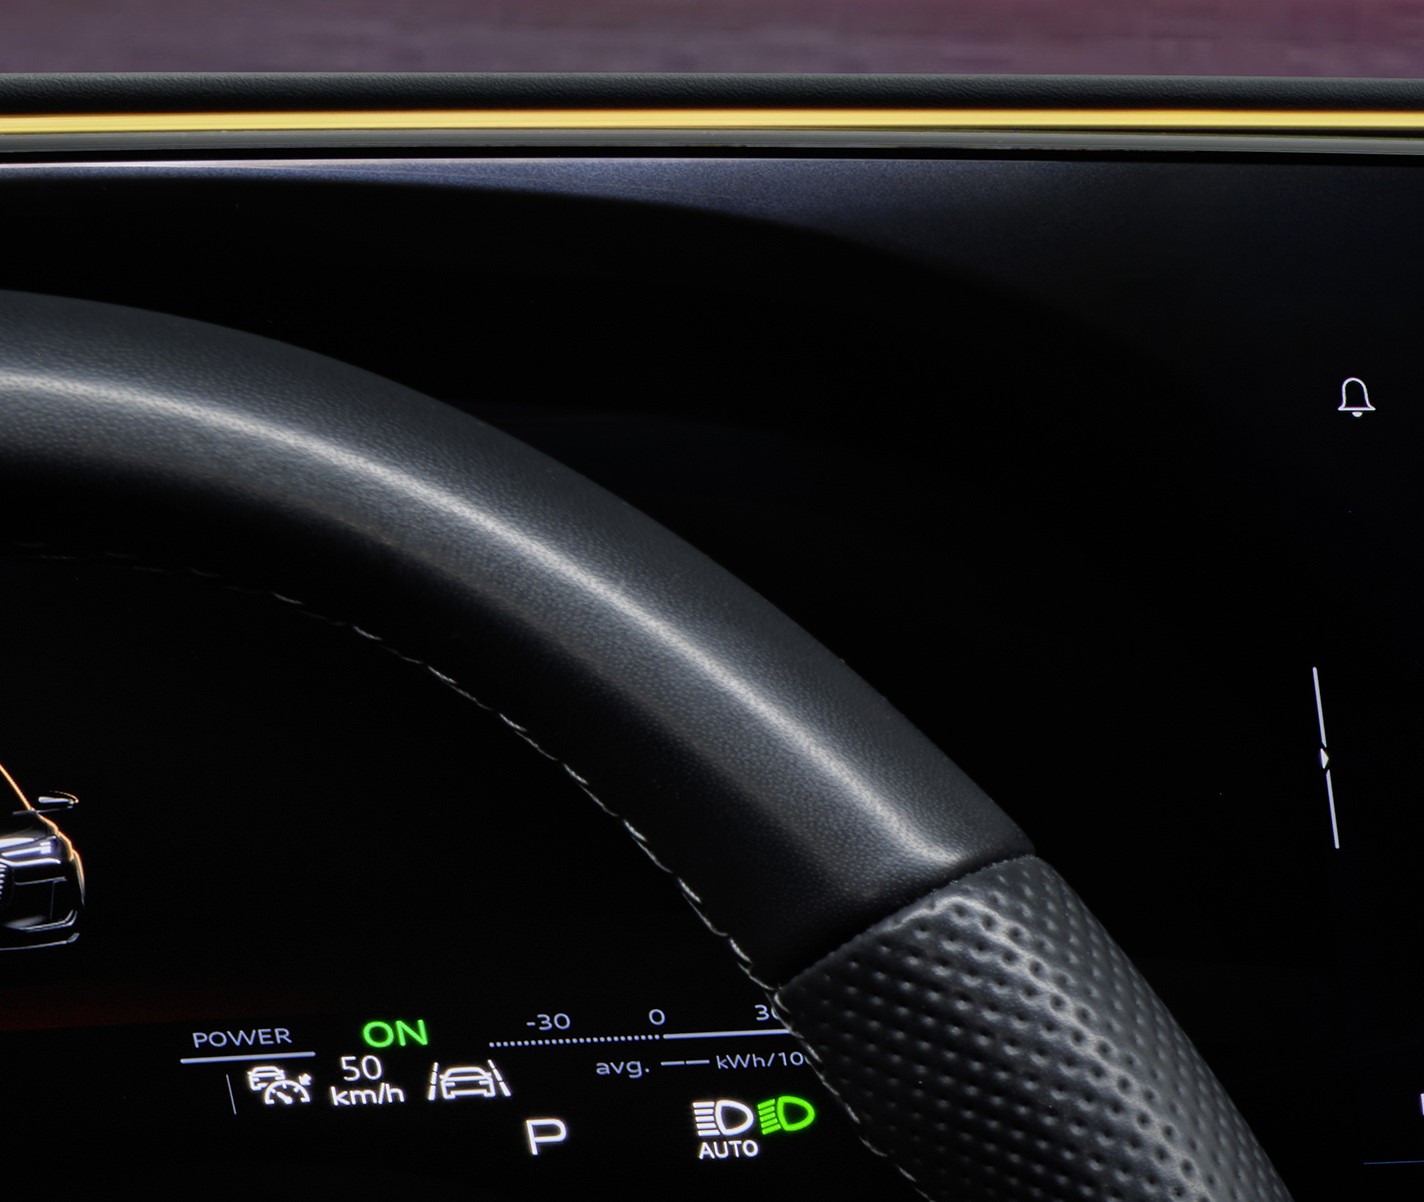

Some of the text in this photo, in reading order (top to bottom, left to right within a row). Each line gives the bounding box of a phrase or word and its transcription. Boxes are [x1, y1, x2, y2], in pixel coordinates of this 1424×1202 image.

[527, 1013, 571, 1031] -30
[648, 1008, 666, 1026] 0
[193, 1028, 292, 1048] POWER
[362, 1019, 428, 1048] ON
[341, 1055, 383, 1081] 50
[596, 1051, 811, 1079] avg. kWh/10
[330, 1082, 405, 1106] km/h
[525, 1118, 568, 1156] P
[699, 1139, 759, 1160] AUTO
